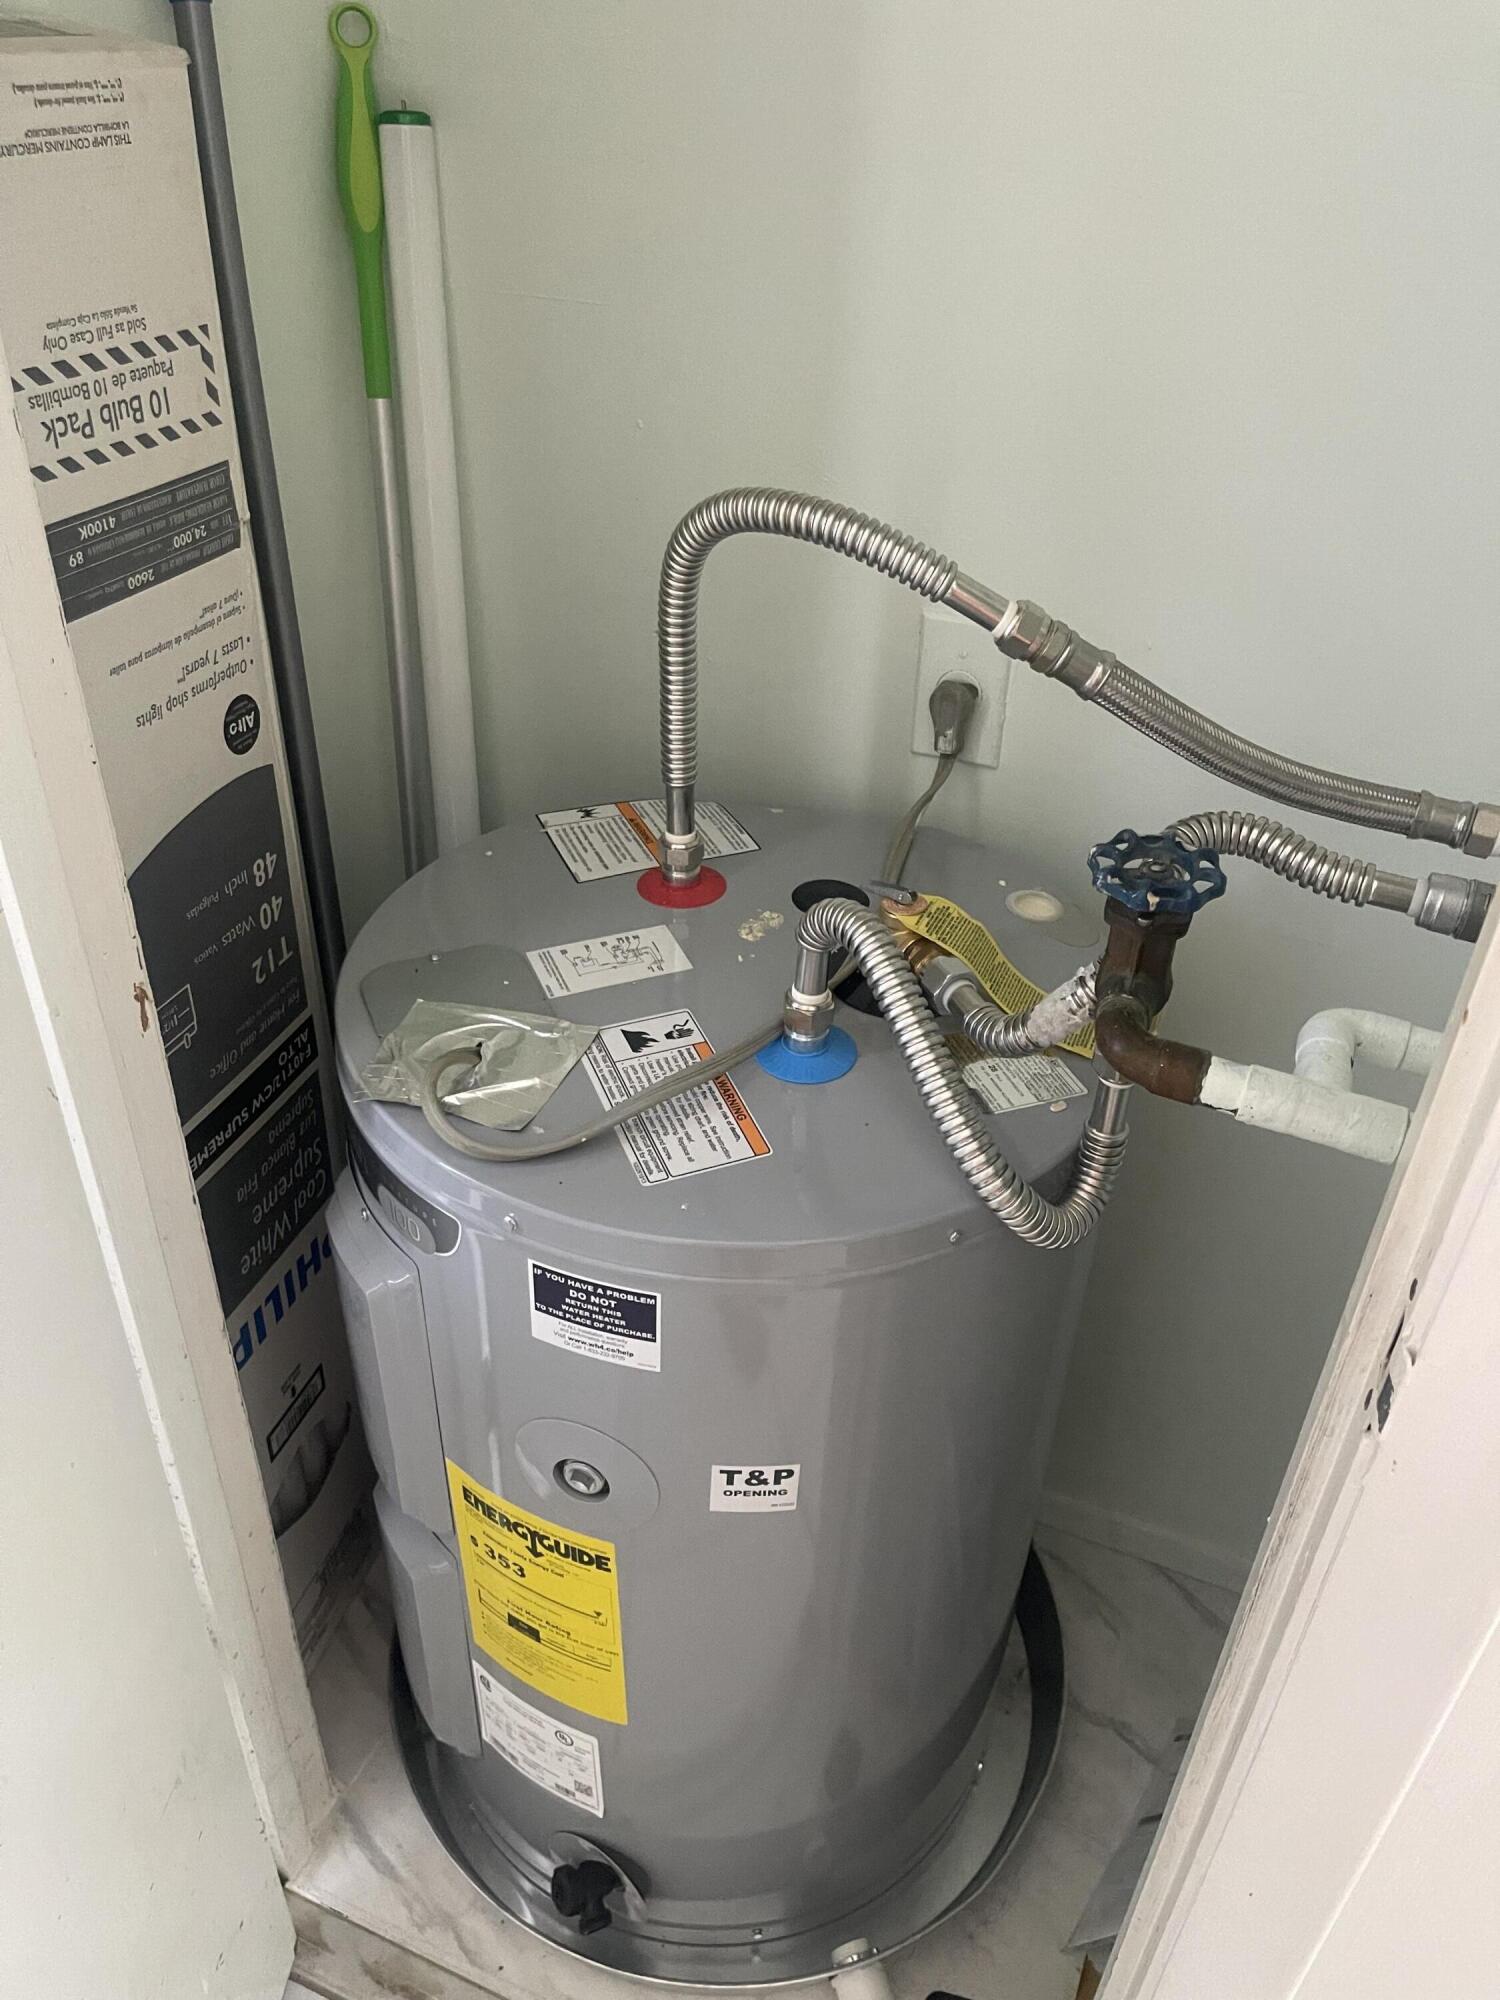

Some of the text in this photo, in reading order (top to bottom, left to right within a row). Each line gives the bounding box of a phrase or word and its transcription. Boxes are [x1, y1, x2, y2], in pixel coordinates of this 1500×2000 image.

[122, 121, 130, 130] LA
[44, 137, 91, 153] CONTAINS
[92, 135, 113, 149] LAMP
[113, 133, 132, 145] THIS
[91, 312, 100, 322] La
[42, 317, 147, 353] Sold as Full Case Only
[27, 359, 174, 412] Paquete de 10 Bombillas
[40, 386, 170, 450] 10 Bulb Pack
[77, 515, 117, 541] 4100K
[68, 551, 85, 568] 89
[127, 568, 155, 590] 2600
[219, 599, 223, 609] 7
[174, 635, 183, 646] de
[221, 636, 244, 657] Lasts
[127, 651, 143, 668] para
[213, 649, 219, 665] 7
[136, 659, 247, 728] Outperforms shop lights
[185, 852, 278, 920] 48 Inch Pulgadas
[193, 895, 283, 965] 40 Watts Vatios
[251, 936, 294, 985] T12
[239, 1030, 258, 1057] and
[278, 1028, 310, 1066] ALTO
[209, 1049, 238, 1080] Office
[646, 1060, 655, 1069] Use
[706, 1085, 719, 1101] reduce
[715, 1101, 724, 1110] the
[720, 1110, 730, 1120] risk
[715, 1079, 748, 1121] WARNING
[268, 1089, 314, 1144] Suprema
[300, 1109, 316, 1135] Luz
[189, 1107, 249, 1173] SUPREME
[709, 1125, 719, 1135] See
[260, 1132, 296, 1177] Blanca
[250, 1138, 322, 1226] Supreme
[240, 1168, 327, 1276] Cool White
[533, 1267, 543, 1275] IF
[545, 1272, 565, 1284] YOU
[567, 1279, 594, 1292] HAVE
[606, 1290, 656, 1305] PROBLEM
[569, 1289, 618, 1308] DO NOT
[561, 1305, 627, 1326] WATER HEATER
[565, 1298, 622, 1317] RETURN THIS
[535, 1302, 656, 1340] TO THE PLACE OF PURCHASE.
[553, 1329, 567, 1338] Visit
[720, 1469, 795, 1486] T&P
[723, 1489, 788, 1497] OPENING
[462, 1485, 612, 1573] ENERGYGUIDE
[483, 1543, 526, 1578] 353
